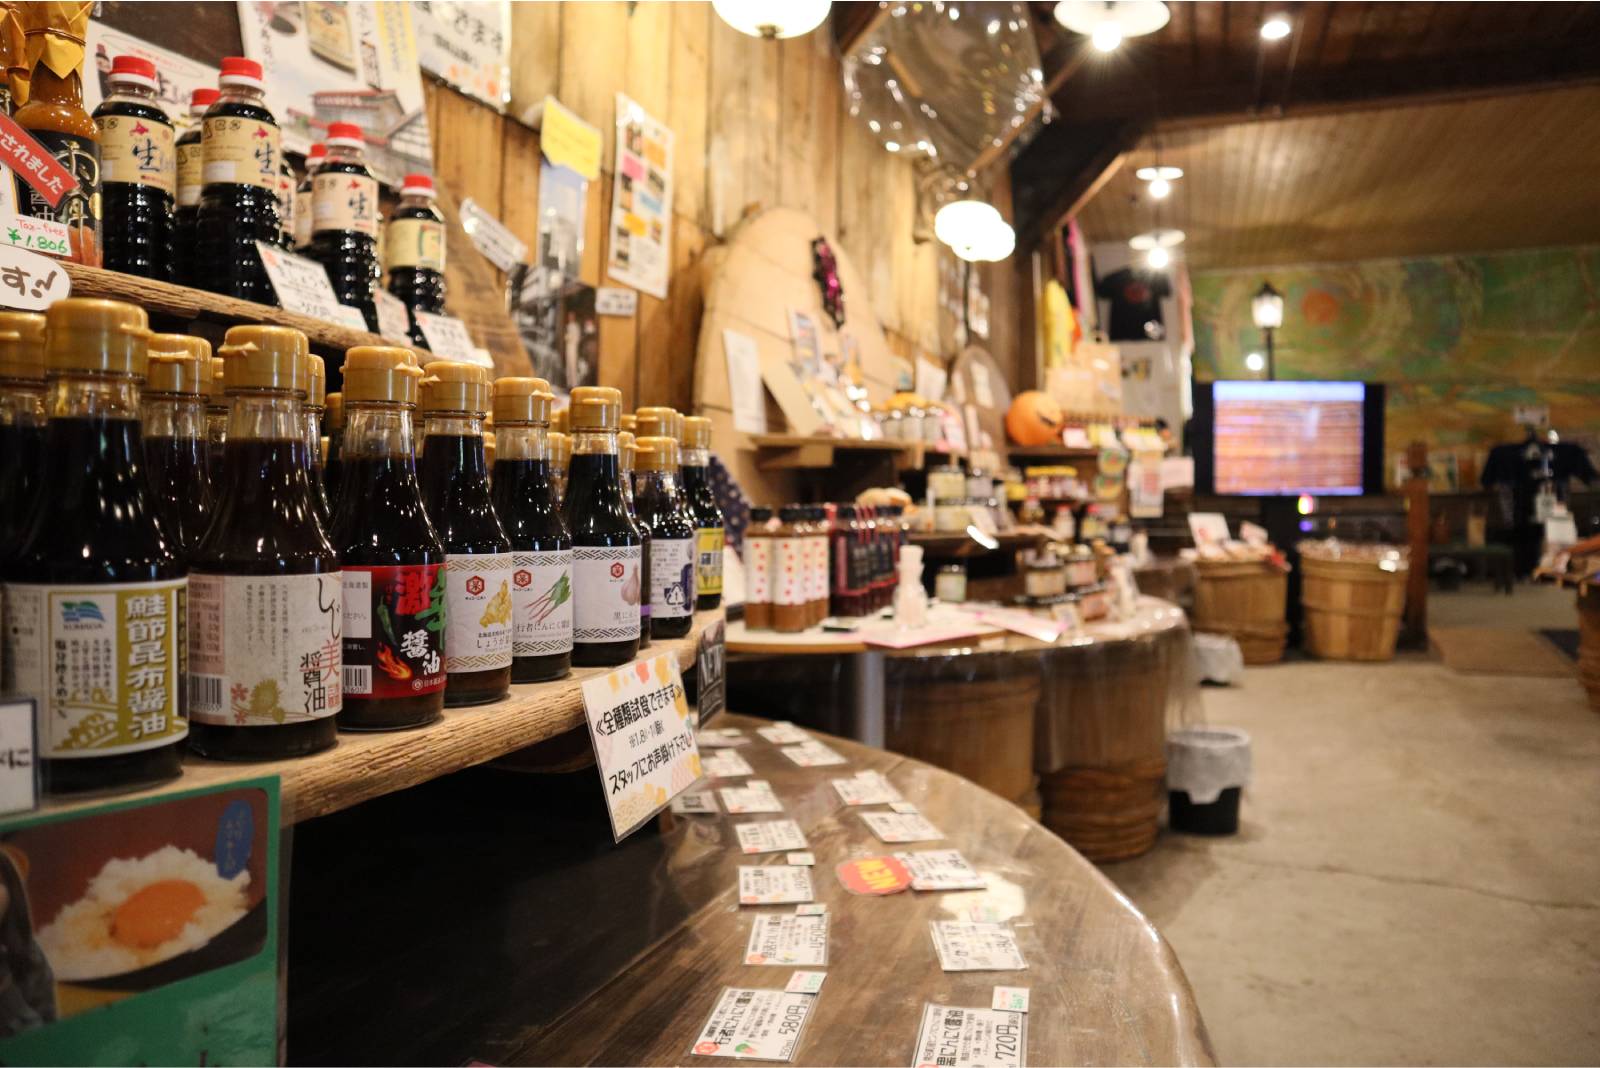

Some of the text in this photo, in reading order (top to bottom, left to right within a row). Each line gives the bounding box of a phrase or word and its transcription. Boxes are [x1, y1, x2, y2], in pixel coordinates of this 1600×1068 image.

[0, 128, 64, 194] されました
[125, 594, 168, 741] 鮭節昆布醤油
[399, 628, 441, 676] 醤油
[608, 731, 693, 796] スタッフにお声掛け下さい
[857, 860, 902, 891] NEW
[777, 1004, 808, 1035] 580円
[936, 1009, 964, 1067] 黒にんにく醤油
[994, 1023, 1019, 1061] 720円
